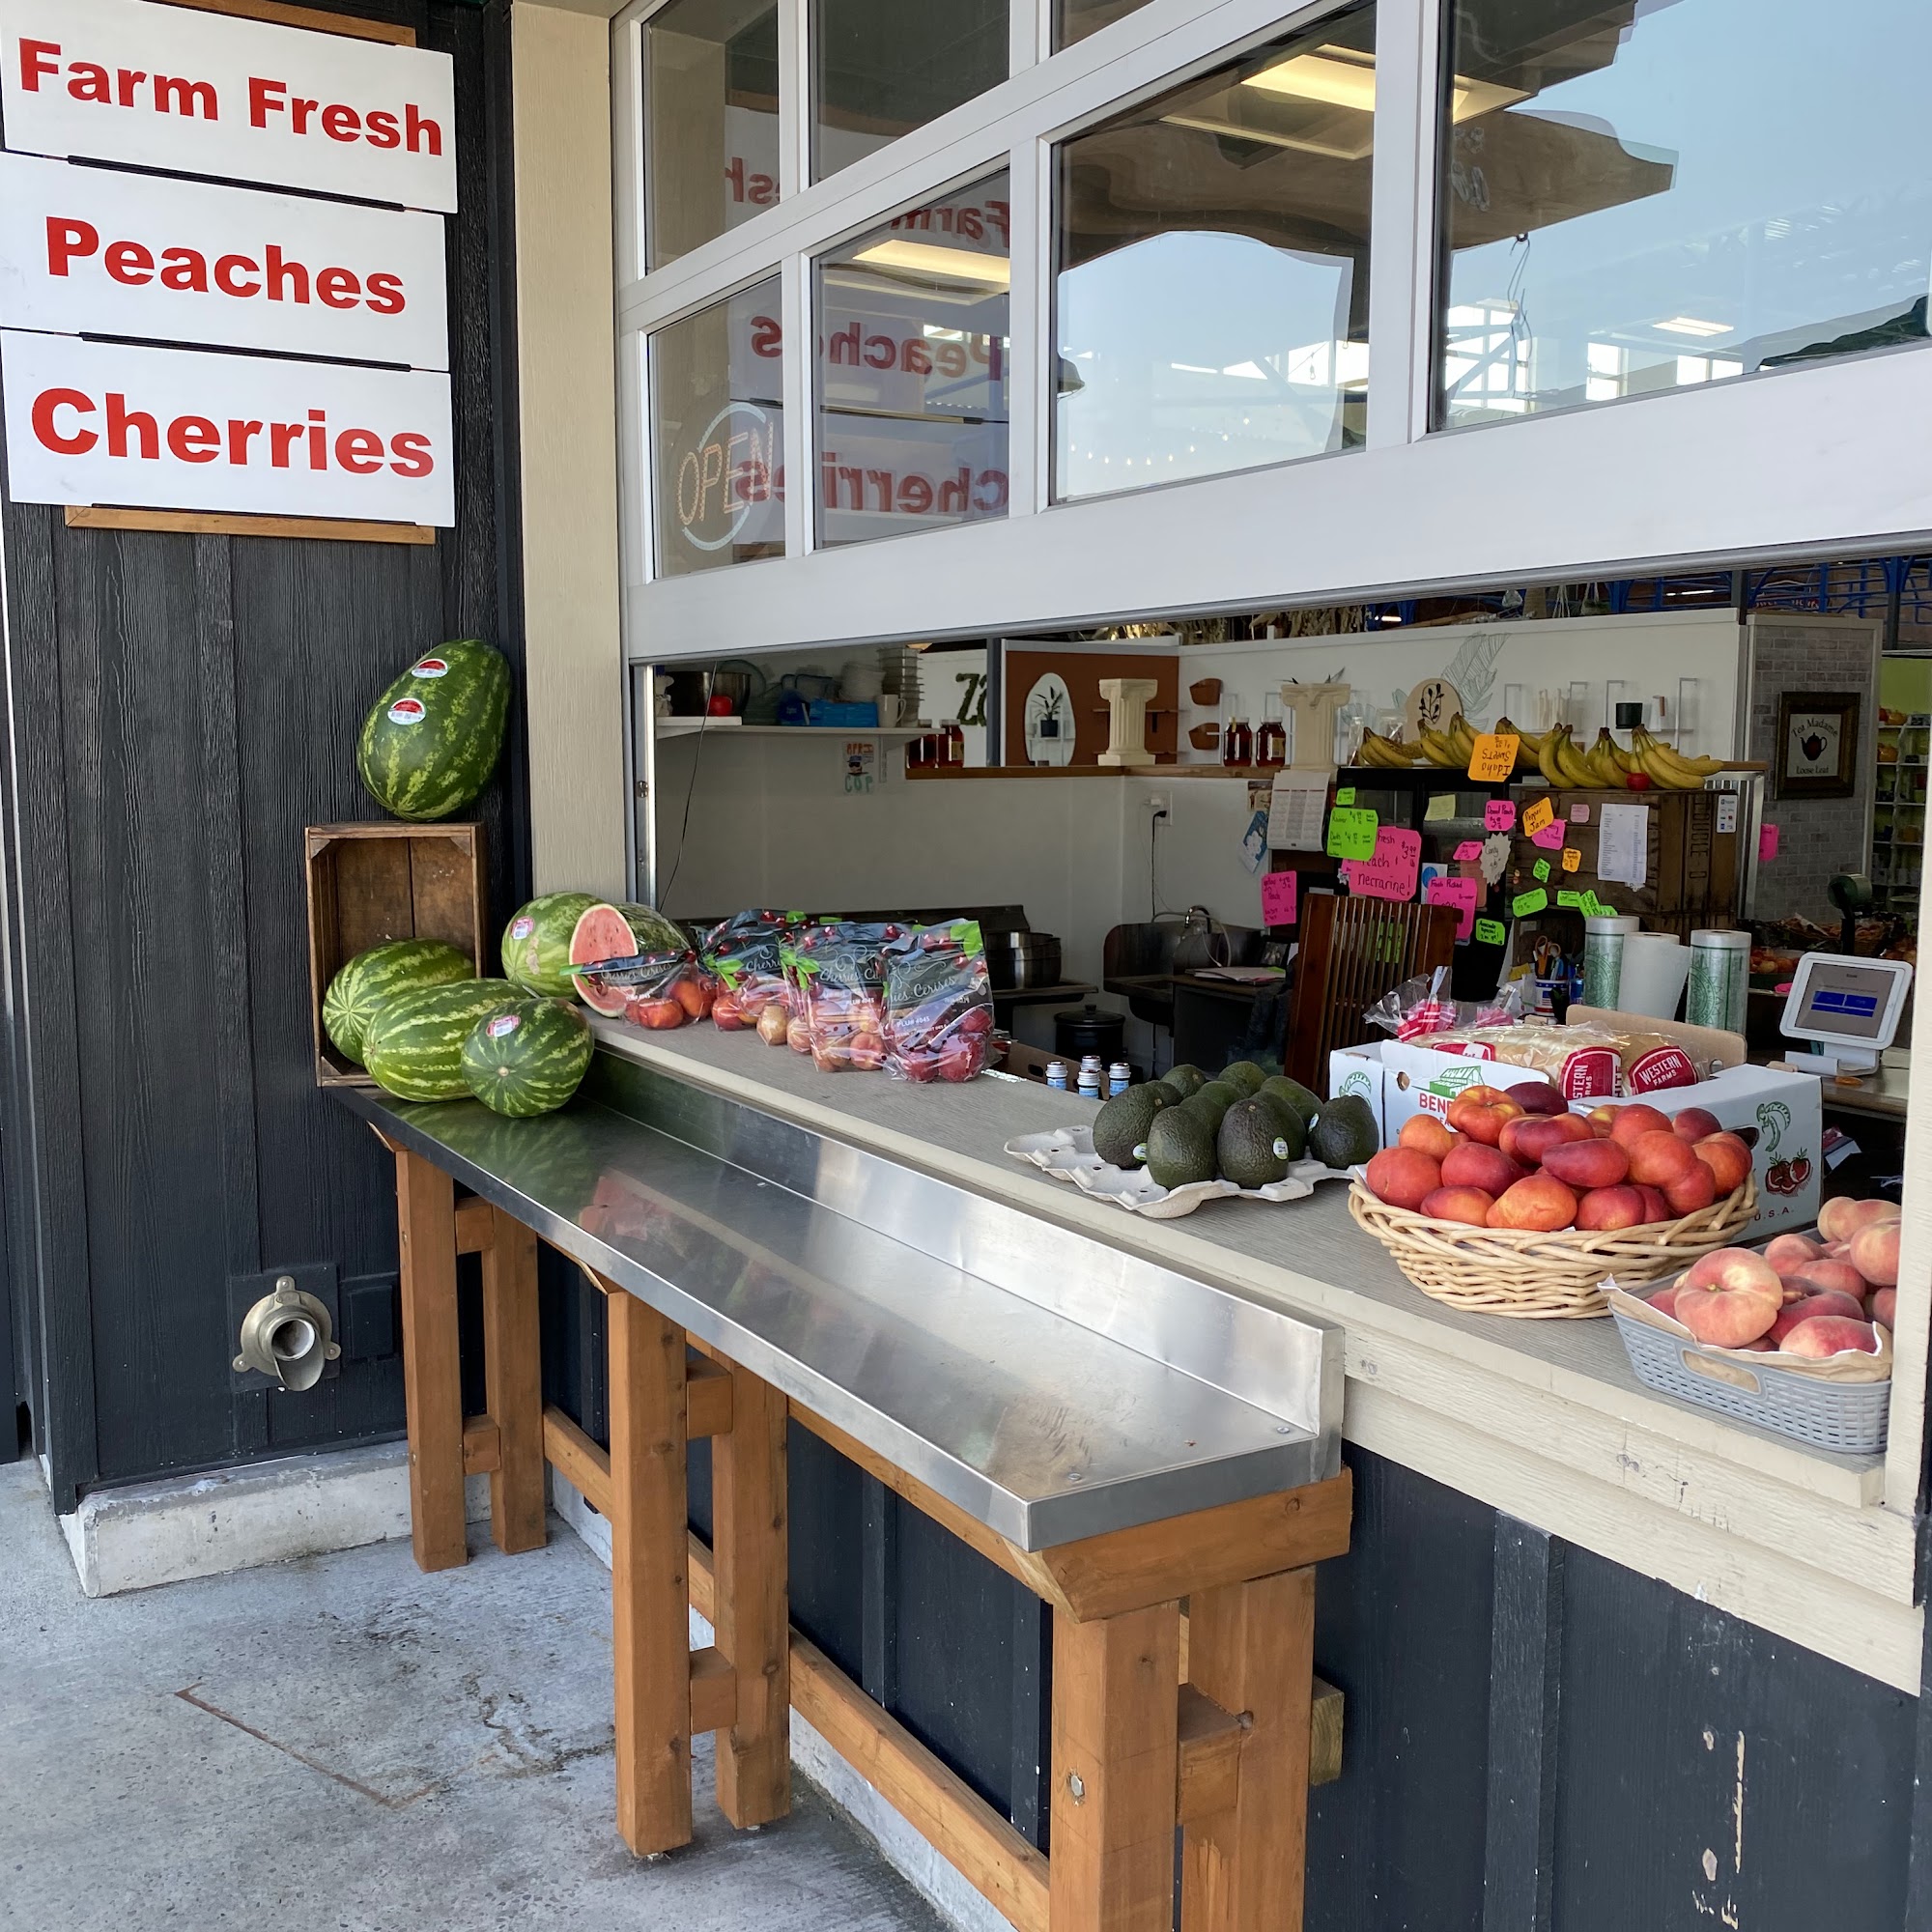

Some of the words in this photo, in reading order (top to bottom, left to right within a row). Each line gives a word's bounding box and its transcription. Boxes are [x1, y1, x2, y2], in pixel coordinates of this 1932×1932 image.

[17, 37, 218, 122] Farm
[247, 76, 442, 156] Fresh
[45, 215, 407, 315] Peaches
[31, 386, 435, 478] Cherries
[677, 421, 774, 526] OPEN
[1790, 724, 1805, 738] Tea
[1481, 762, 1511, 777] Idaho
[1529, 818, 1546, 833] Jam
[913, 975, 955, 998] Cerises
[1638, 1054, 1683, 1086] WESTERN
[1653, 1068, 1677, 1087] FARMS
